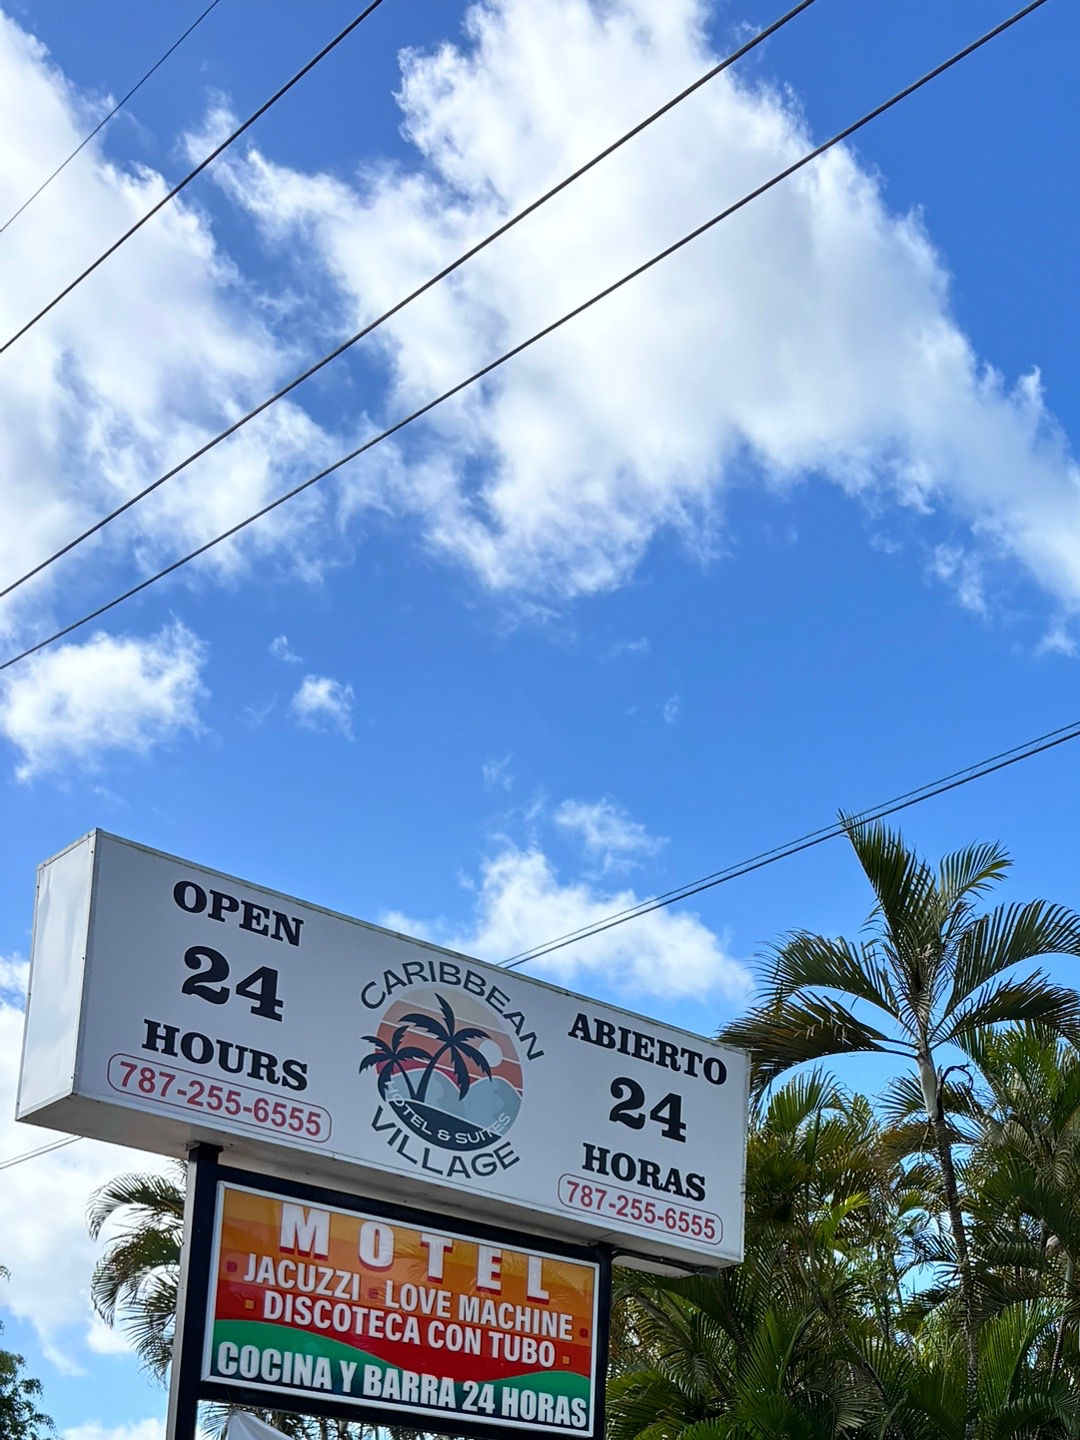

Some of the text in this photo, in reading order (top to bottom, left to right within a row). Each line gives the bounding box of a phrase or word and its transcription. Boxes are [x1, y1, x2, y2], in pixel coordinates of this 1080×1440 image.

[173, 880, 304, 947] OPEN
[181, 945, 284, 1022] 24
[360, 960, 545, 1061] CARIBBEAN
[141, 1018, 308, 1091] HOURS
[567, 1012, 728, 1086] ABIERTO
[119, 1060, 322, 1137] 787-255-6555
[384, 1080, 511, 1144] HOTEL & SUITES
[608, 1076, 687, 1143] 24
[370, 1104, 521, 1179] VILLAGE
[581, 1142, 706, 1202] HORAS
[566, 1180, 716, 1240] 787-255-6555
[279, 1202, 550, 1304] MOTEL
[243, 1253, 573, 1341] JACUZZI LOVE MACHINE
[263, 1290, 556, 1368] DISCOTECA CON TUBO
[216, 1341, 587, 1428] COCINA Y BARRA 24 HORAS
